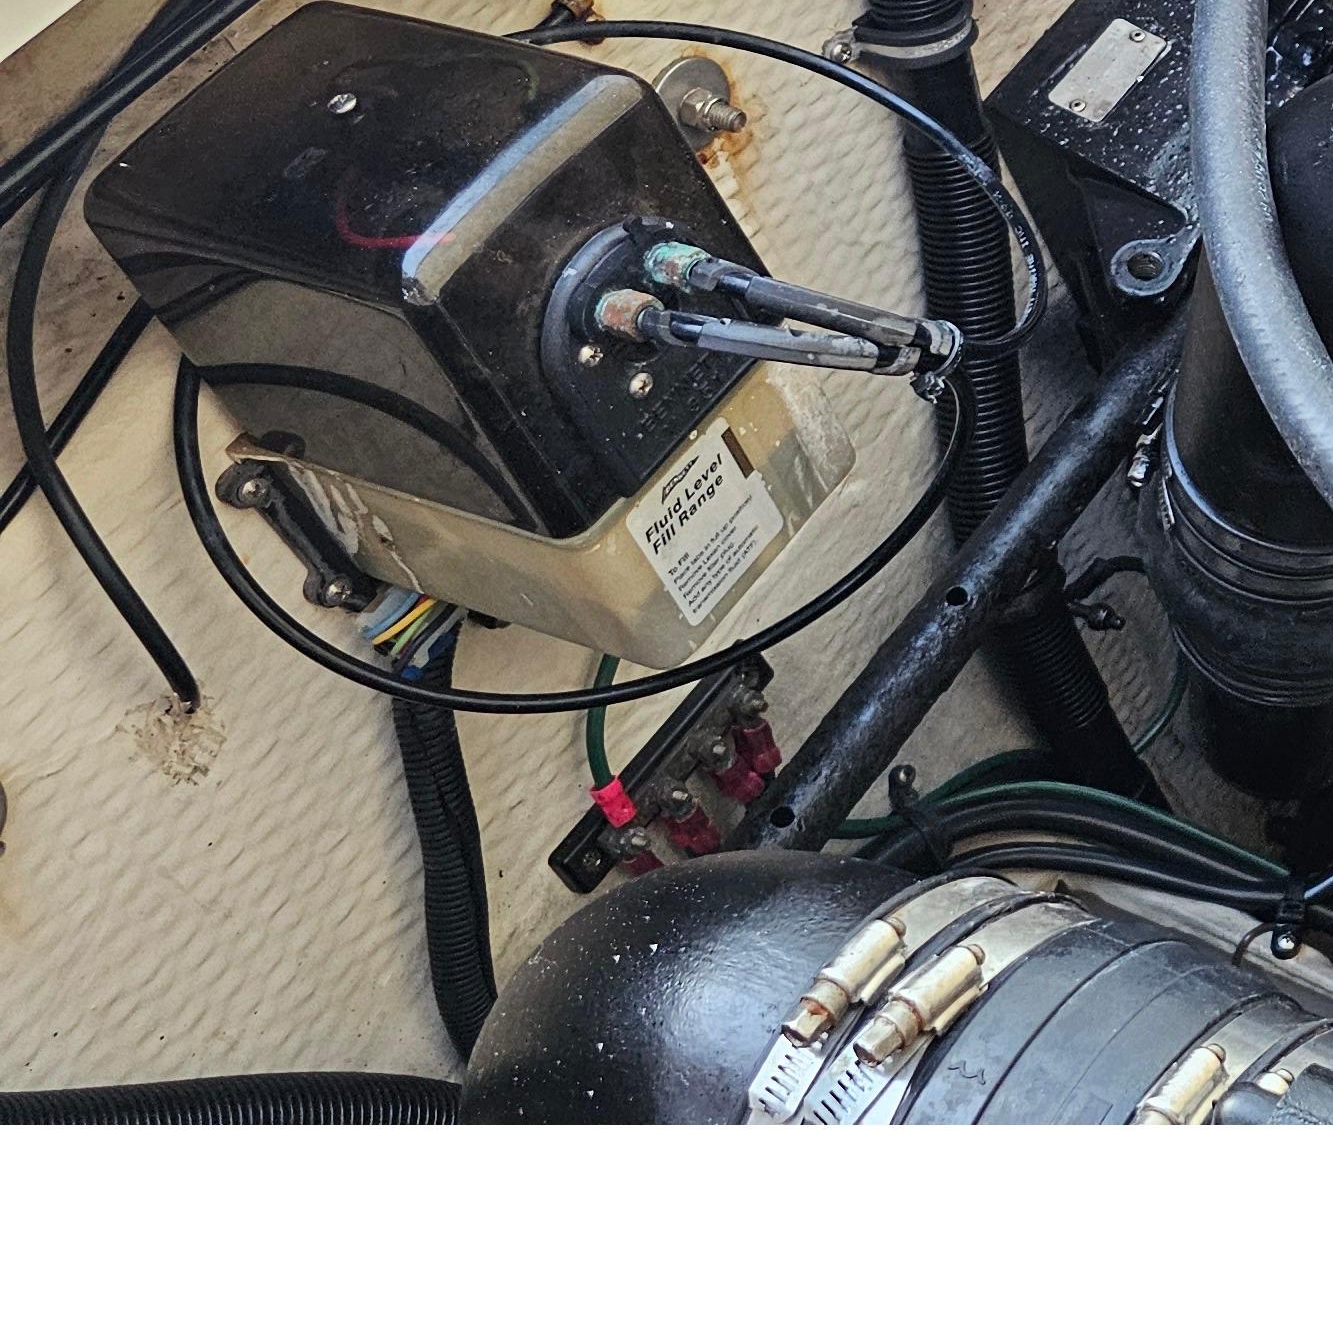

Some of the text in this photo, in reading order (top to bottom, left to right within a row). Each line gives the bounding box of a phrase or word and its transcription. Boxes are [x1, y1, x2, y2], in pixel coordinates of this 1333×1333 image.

[645, 496, 682, 543] Fluid
[685, 452, 721, 500] Level
[652, 473, 724, 555] Fill Range
[686, 589, 701, 607] Add
